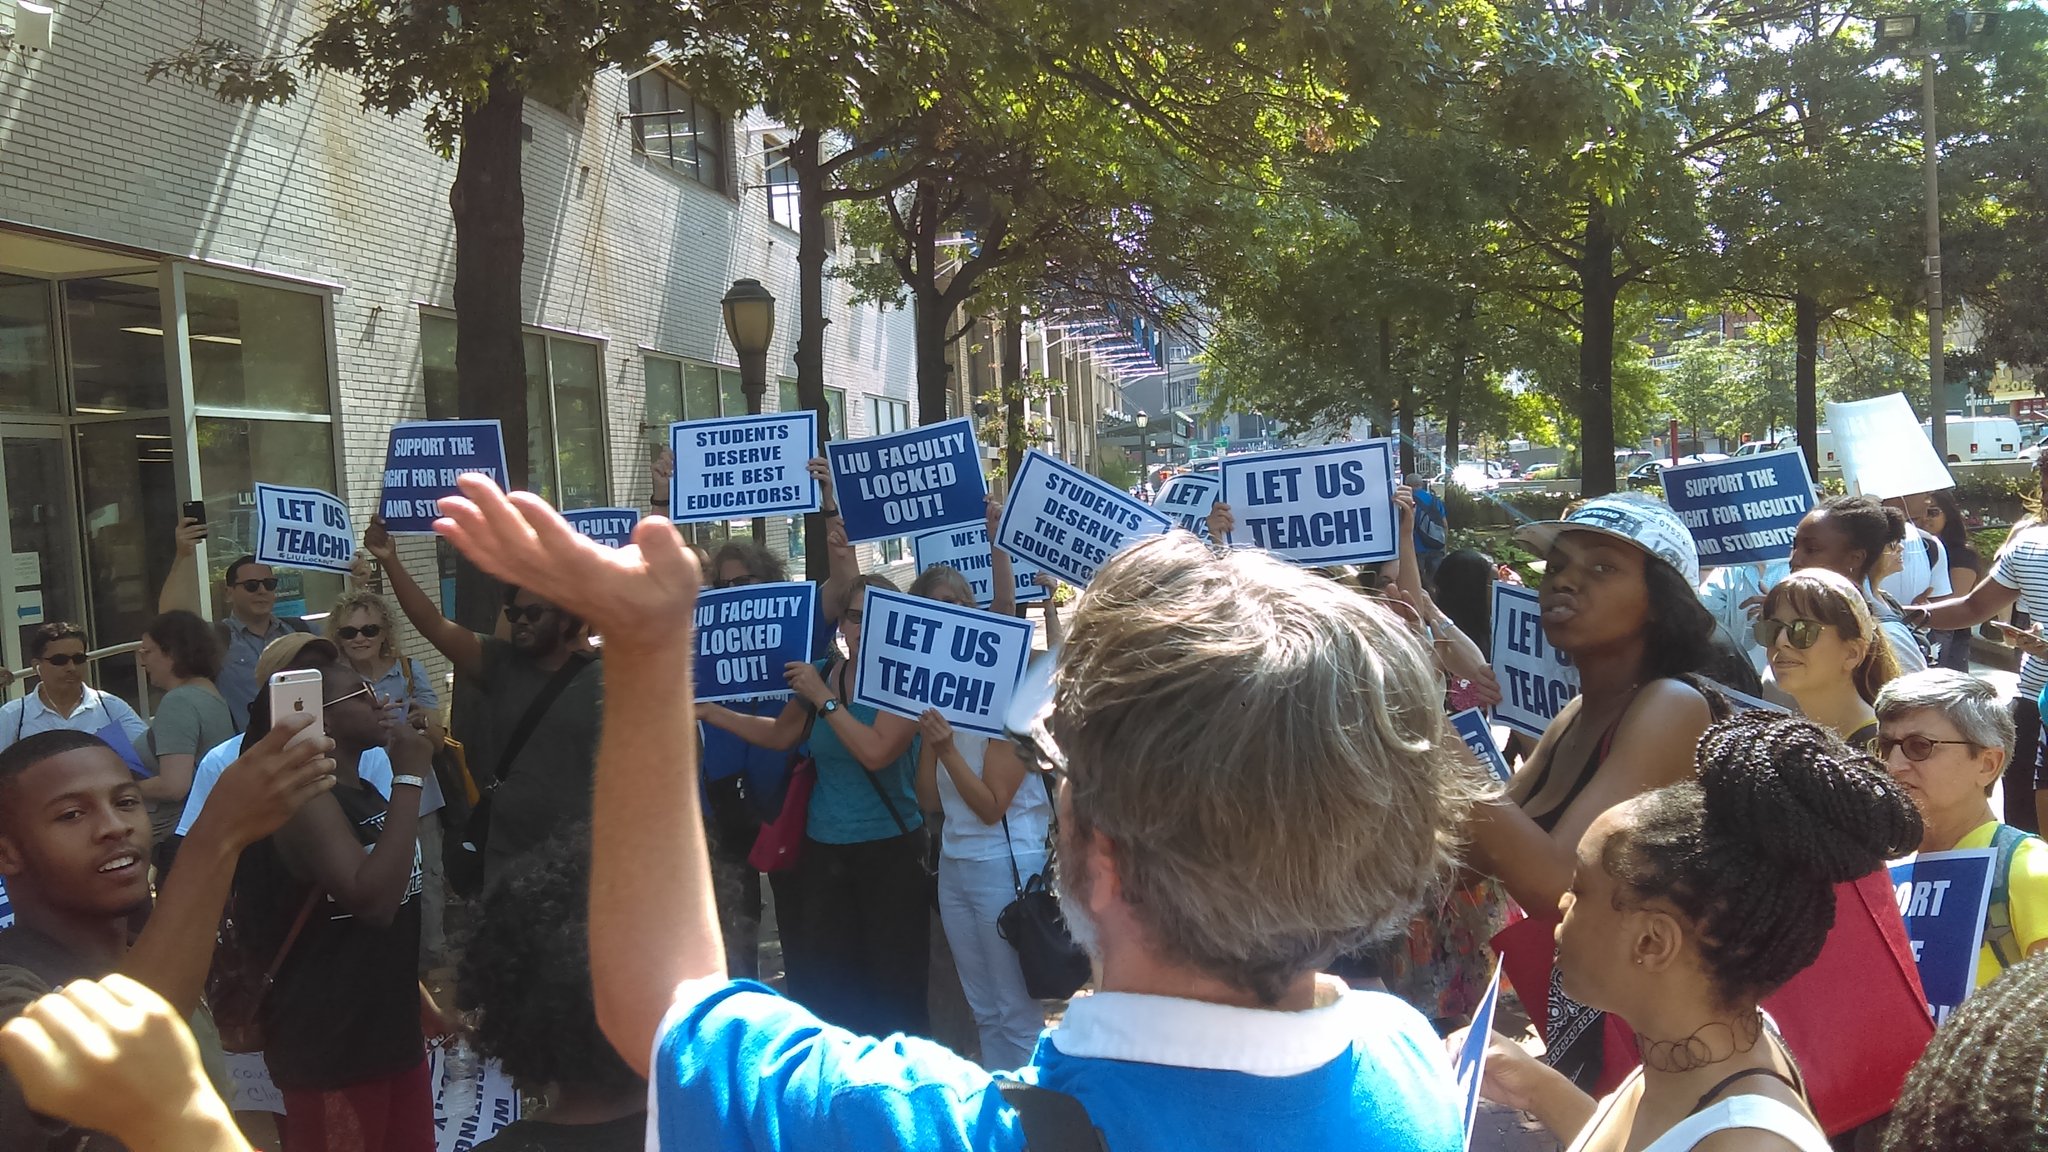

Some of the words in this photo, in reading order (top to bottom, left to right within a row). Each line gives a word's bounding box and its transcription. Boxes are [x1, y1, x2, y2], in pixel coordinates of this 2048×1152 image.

[394, 437, 445, 457] SUPPORT
[449, 437, 475, 455] THE
[696, 425, 788, 447] STUDENTS
[704, 446, 781, 467] DESERVE
[838, 451, 871, 475] LIU
[878, 432, 966, 470] FACULTY
[412, 468, 437, 487] FOR
[702, 471, 734, 488] THE
[742, 466, 785, 485] BEST
[859, 462, 957, 500] LOCKED
[1246, 468, 1302, 506] LET
[1315, 460, 1366, 499] US
[1685, 474, 1745, 498] SUPPORT
[1747, 468, 1778, 490] THE
[385, 500, 413, 518] AND
[687, 486, 800, 510] EDUCATORS!
[883, 493, 945, 525] OUT!
[1046, 472, 1142, 531] STUDENTS
[1165, 483, 1209, 506] LET
[277, 498, 316, 523] LET
[322, 503, 346, 530] US
[1043, 497, 1124, 549] DESERVE
[1677, 511, 1709, 529] IGHT
[1712, 505, 1743, 525] FOR
[1743, 494, 1806, 521] FACULTY
[276, 527, 351, 561] TEACH!
[951, 529, 990, 548] WE'R
[1034, 517, 1067, 546] THE
[1071, 537, 1112, 566] BES
[1246, 507, 1374, 549] TEACH!
[1724, 527, 1799, 551] STUDENTS
[720, 596, 802, 624] FACULTY
[701, 624, 782, 656] LOCKED
[885, 611, 943, 654] LET
[950, 625, 1001, 668] US
[1508, 608, 1542, 658] LET
[716, 655, 768, 685] OUT!
[879, 656, 996, 716] TEACH!
[1505, 665, 1580, 720] TEAC
